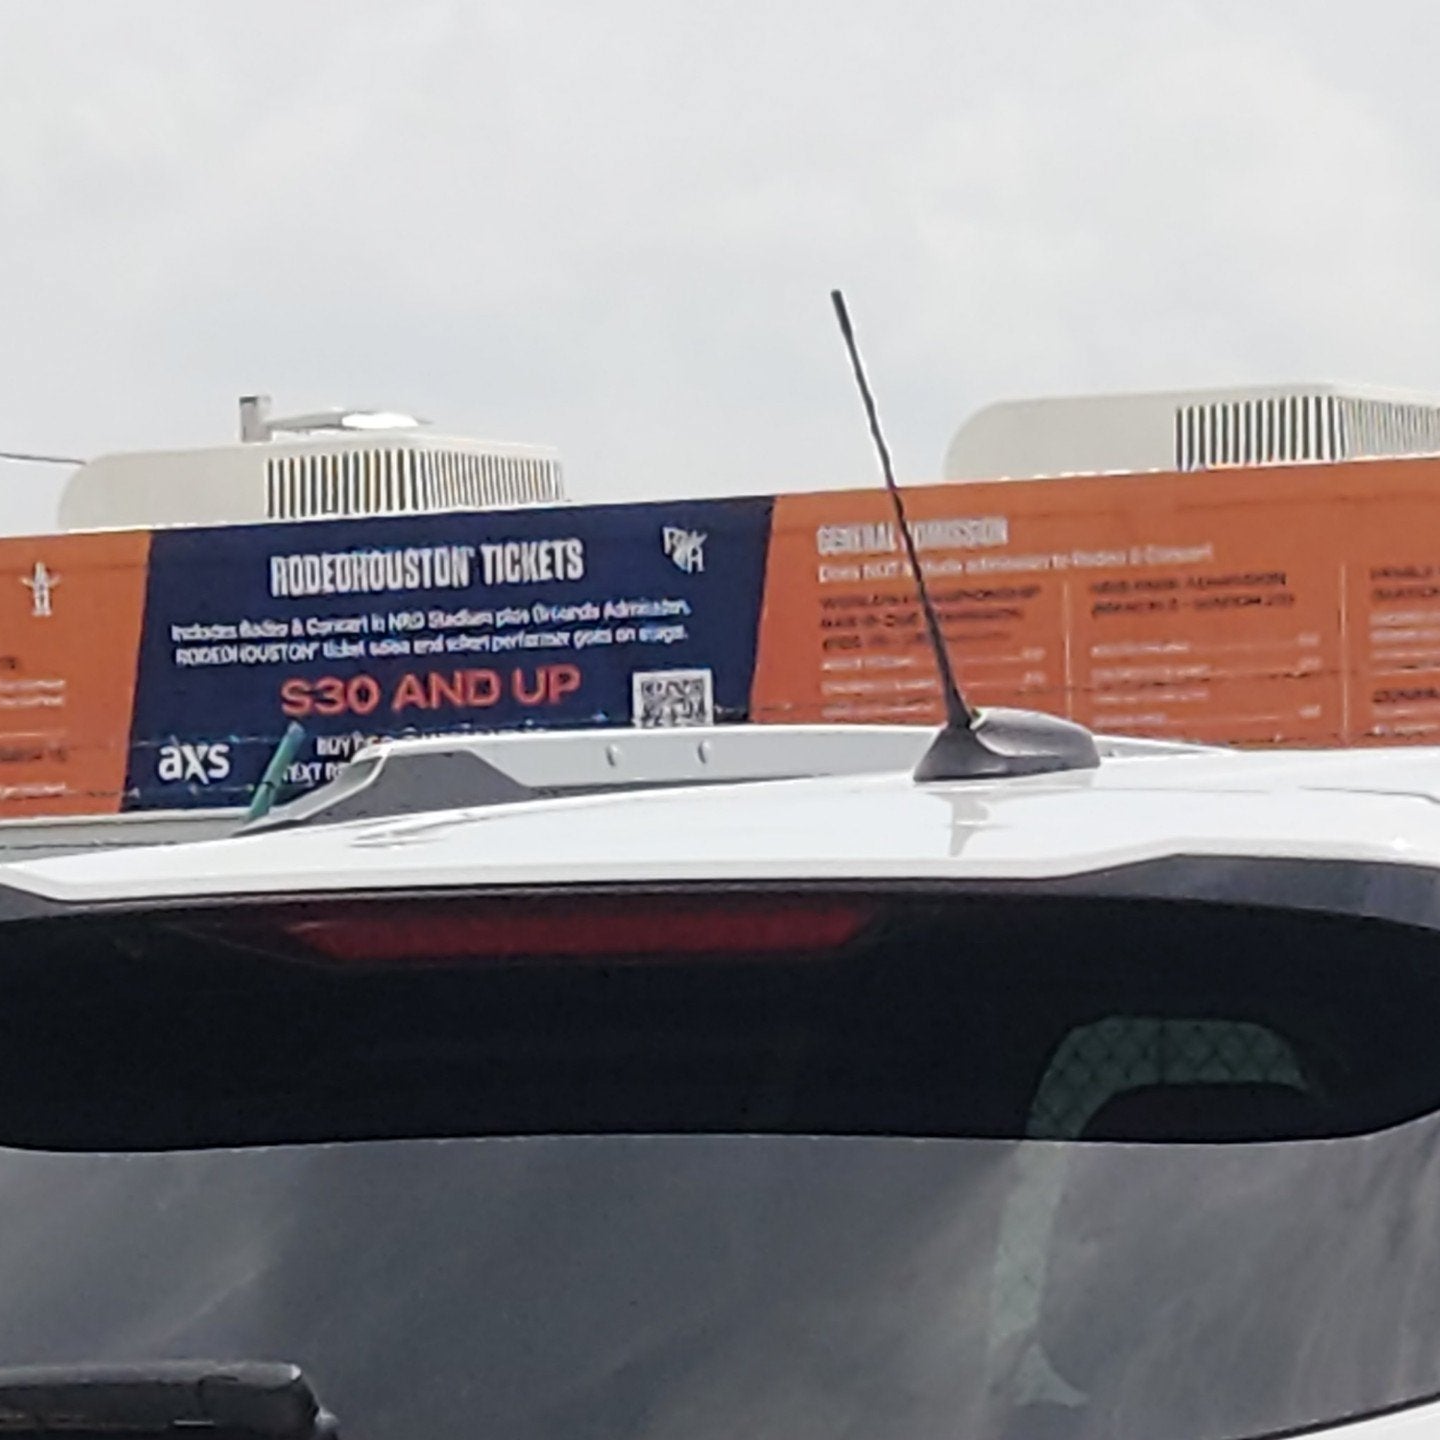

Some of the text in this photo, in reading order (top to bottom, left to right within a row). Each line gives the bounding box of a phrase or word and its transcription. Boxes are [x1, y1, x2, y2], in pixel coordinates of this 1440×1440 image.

[271, 538, 584, 598] RODEOHOUSTON TICKETS
[280, 663, 582, 718] $30 AND UP
[159, 742, 231, 785] axs
